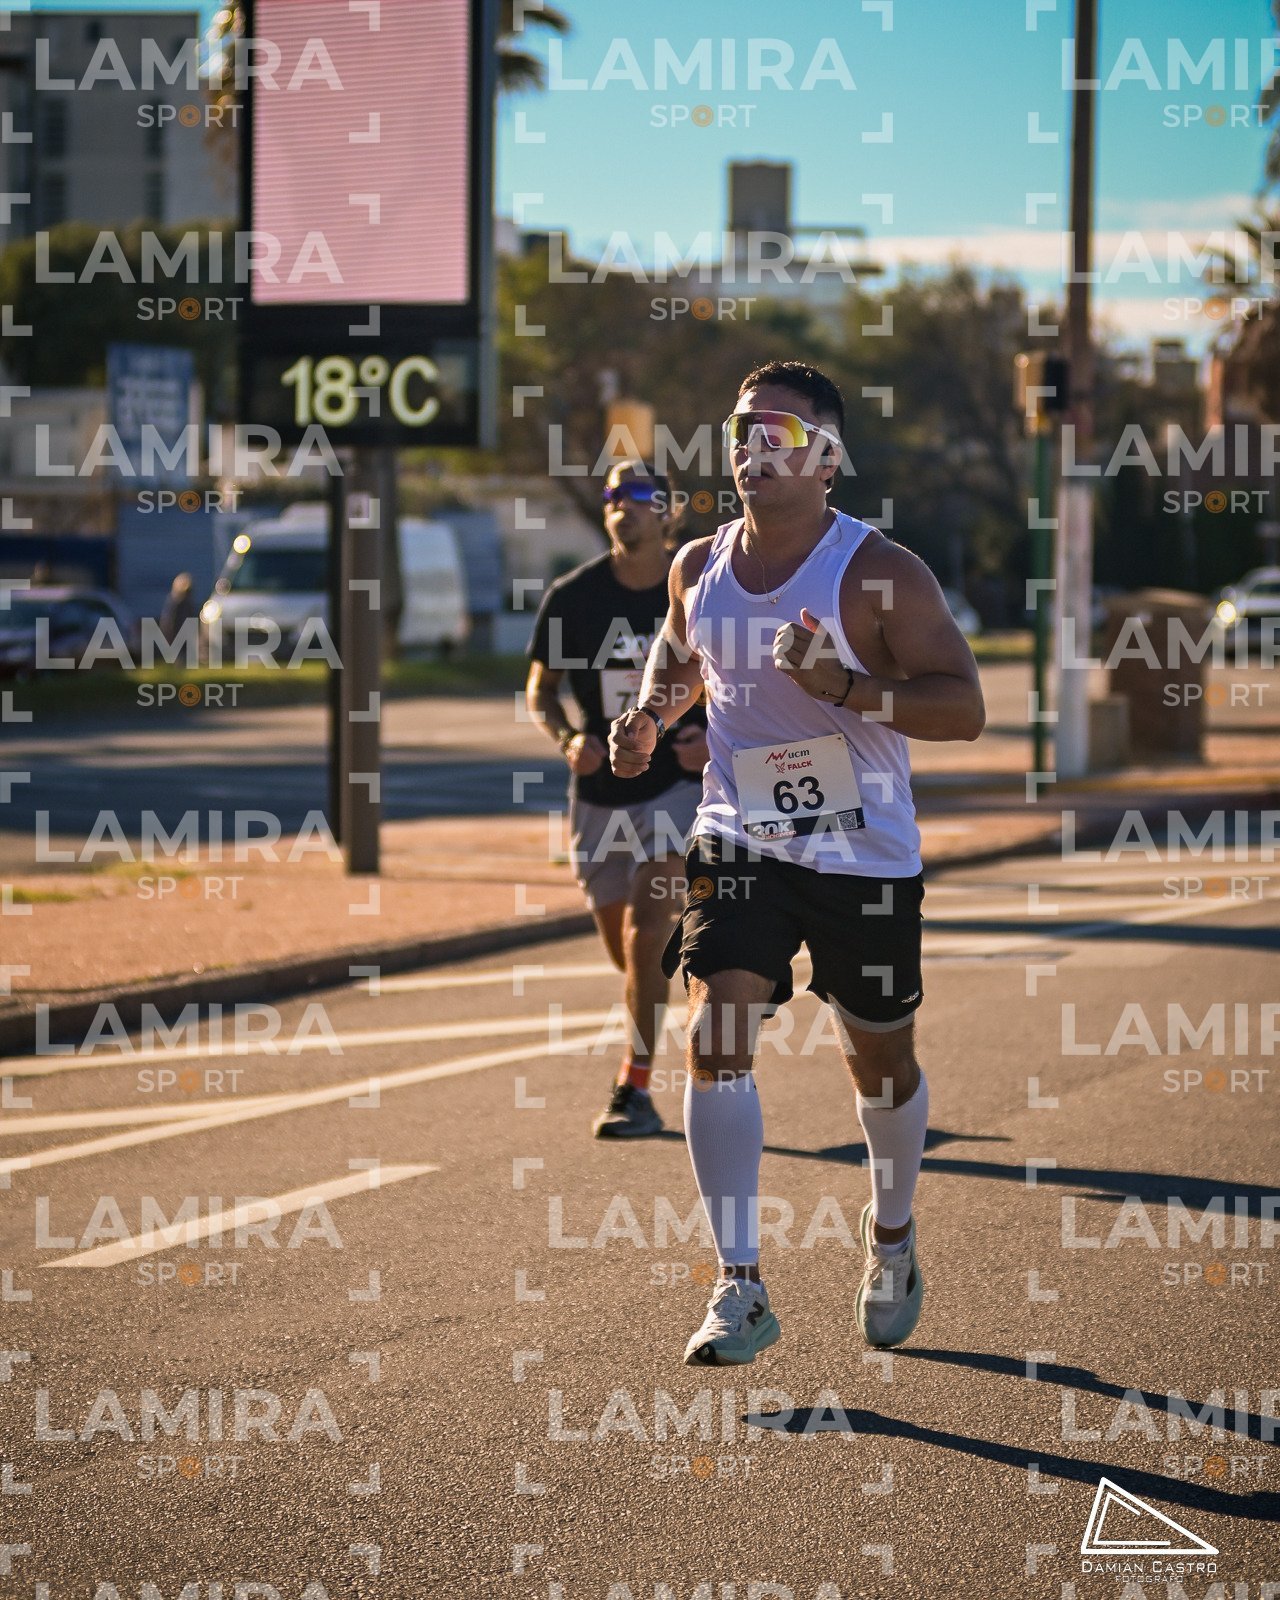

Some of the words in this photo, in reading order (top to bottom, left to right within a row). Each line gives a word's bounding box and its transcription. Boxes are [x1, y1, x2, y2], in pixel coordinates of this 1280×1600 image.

[281, 355, 441, 427] 18°C
[788, 749, 810, 760] ucm
[787, 760, 813, 771] FALCK
[773, 776, 825, 814] 63
[753, 821, 792, 839] 30K
